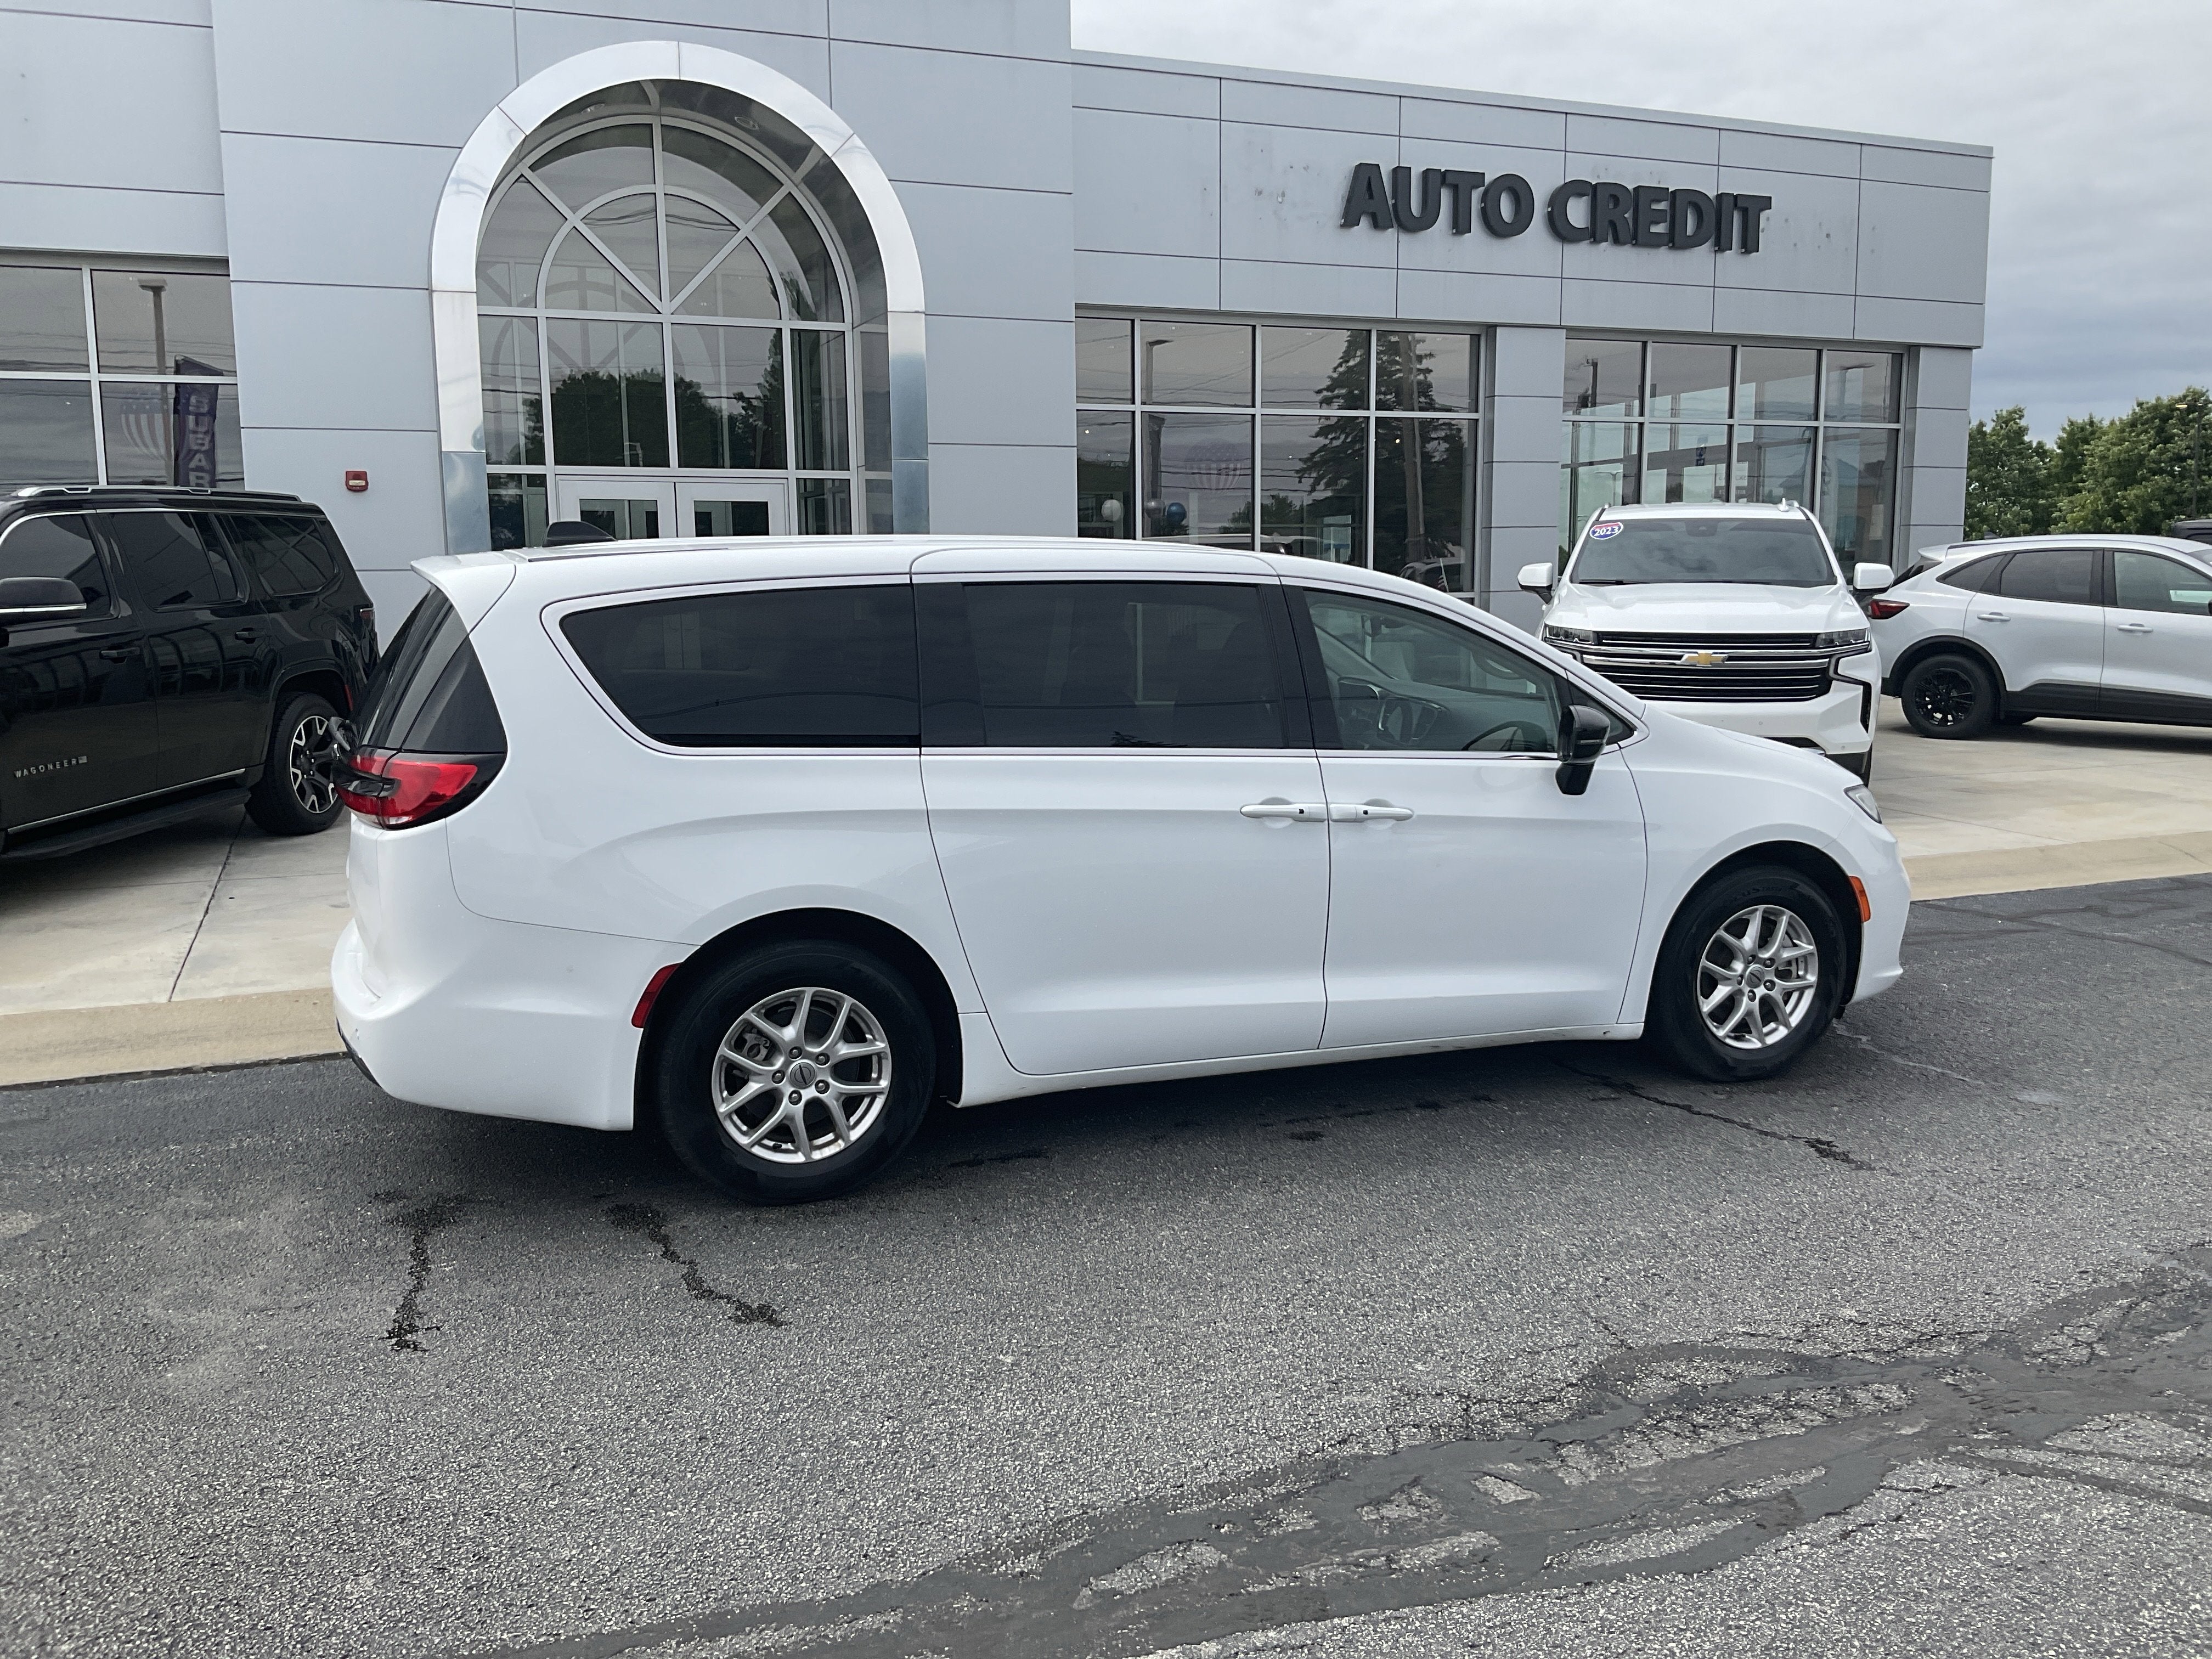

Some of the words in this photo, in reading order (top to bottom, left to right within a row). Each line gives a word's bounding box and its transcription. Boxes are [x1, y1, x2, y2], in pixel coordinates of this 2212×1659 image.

[1340, 162, 1534, 238] AUTO
[1547, 179, 1772, 253] CREDIT
[188, 394, 213, 488] SUBAR
[1593, 526, 1619, 537] 2023
[15, 758, 77, 778] WAGONEER
